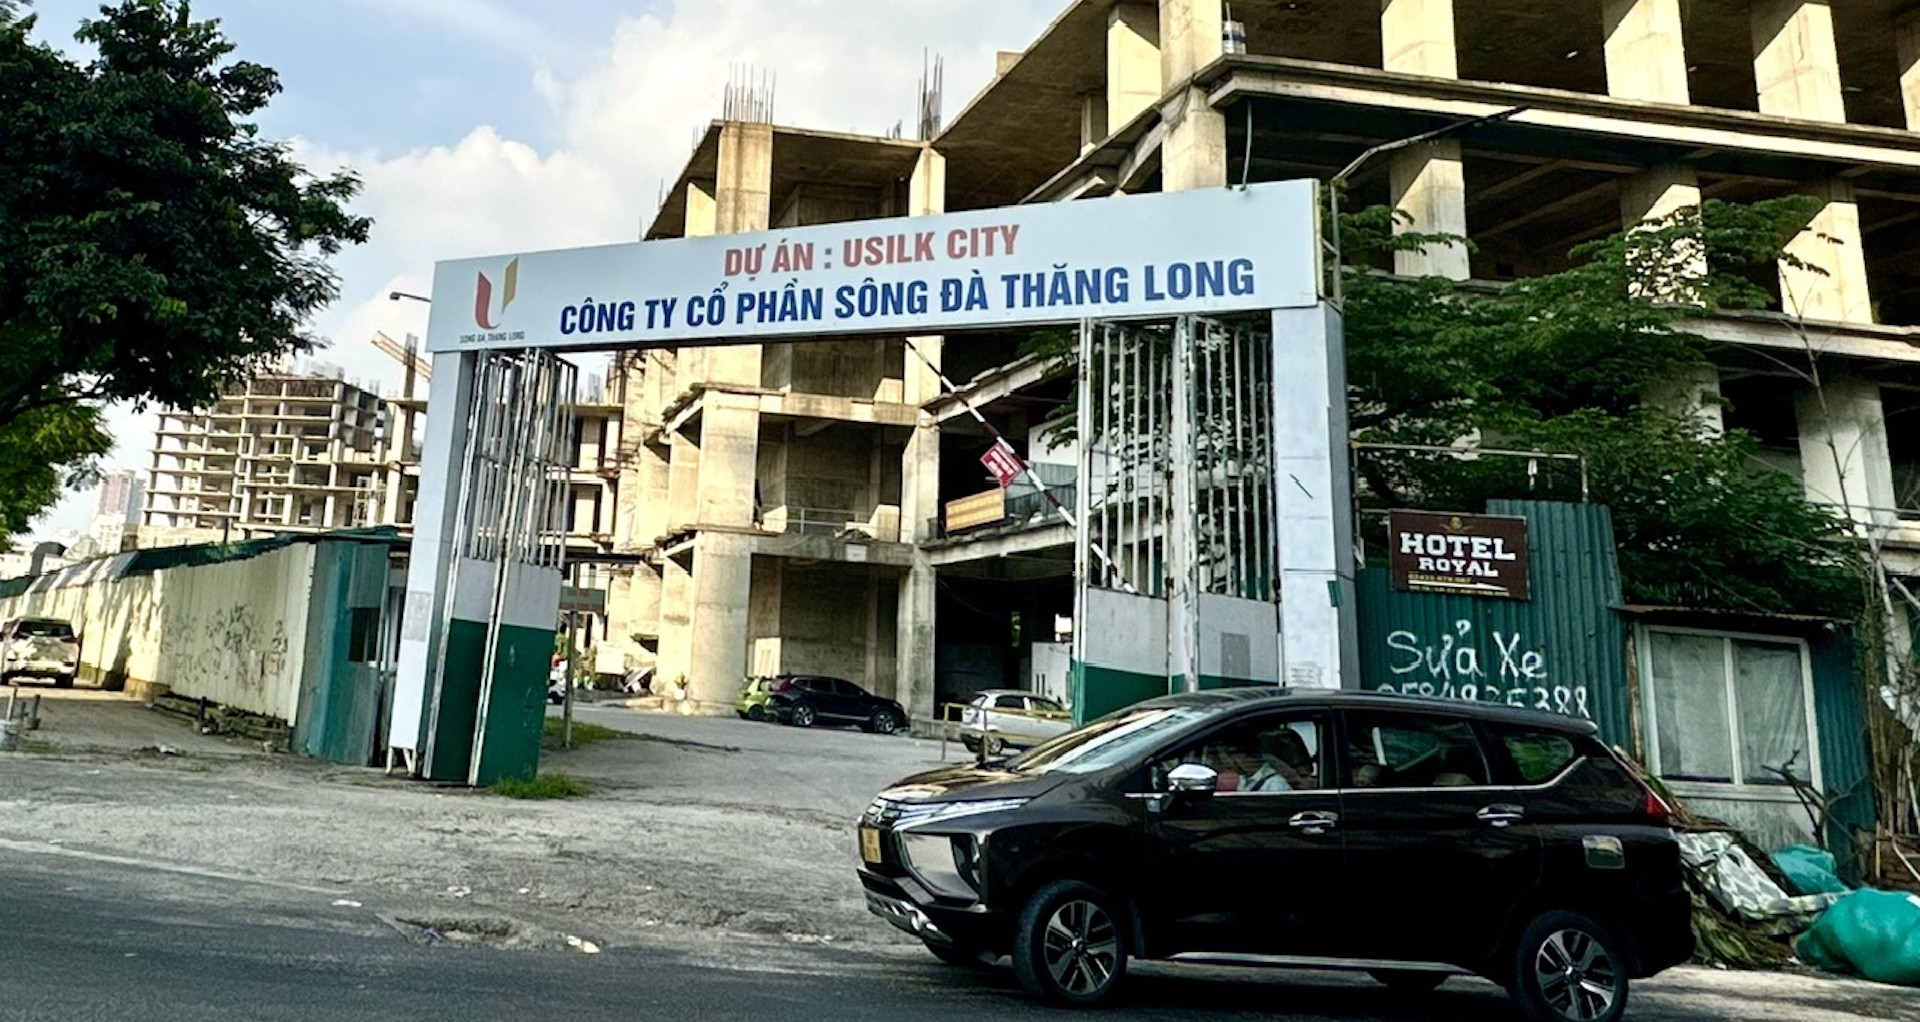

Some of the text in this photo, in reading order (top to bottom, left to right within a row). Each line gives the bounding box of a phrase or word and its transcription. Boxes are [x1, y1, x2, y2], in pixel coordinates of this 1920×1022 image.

[724, 242, 768, 281] DỰ
[771, 239, 814, 272] ÁN
[842, 231, 935, 268] USILK
[946, 224, 1020, 259] CITY
[559, 258, 1255, 335] CÔNG TY CỔ PHẦN SÔNG ĐÀ THĂNG LONG
[1400, 532, 1516, 561] HOTEL
[1418, 557, 1499, 577] ROYAL
[1492, 631, 1548, 684] Xe
